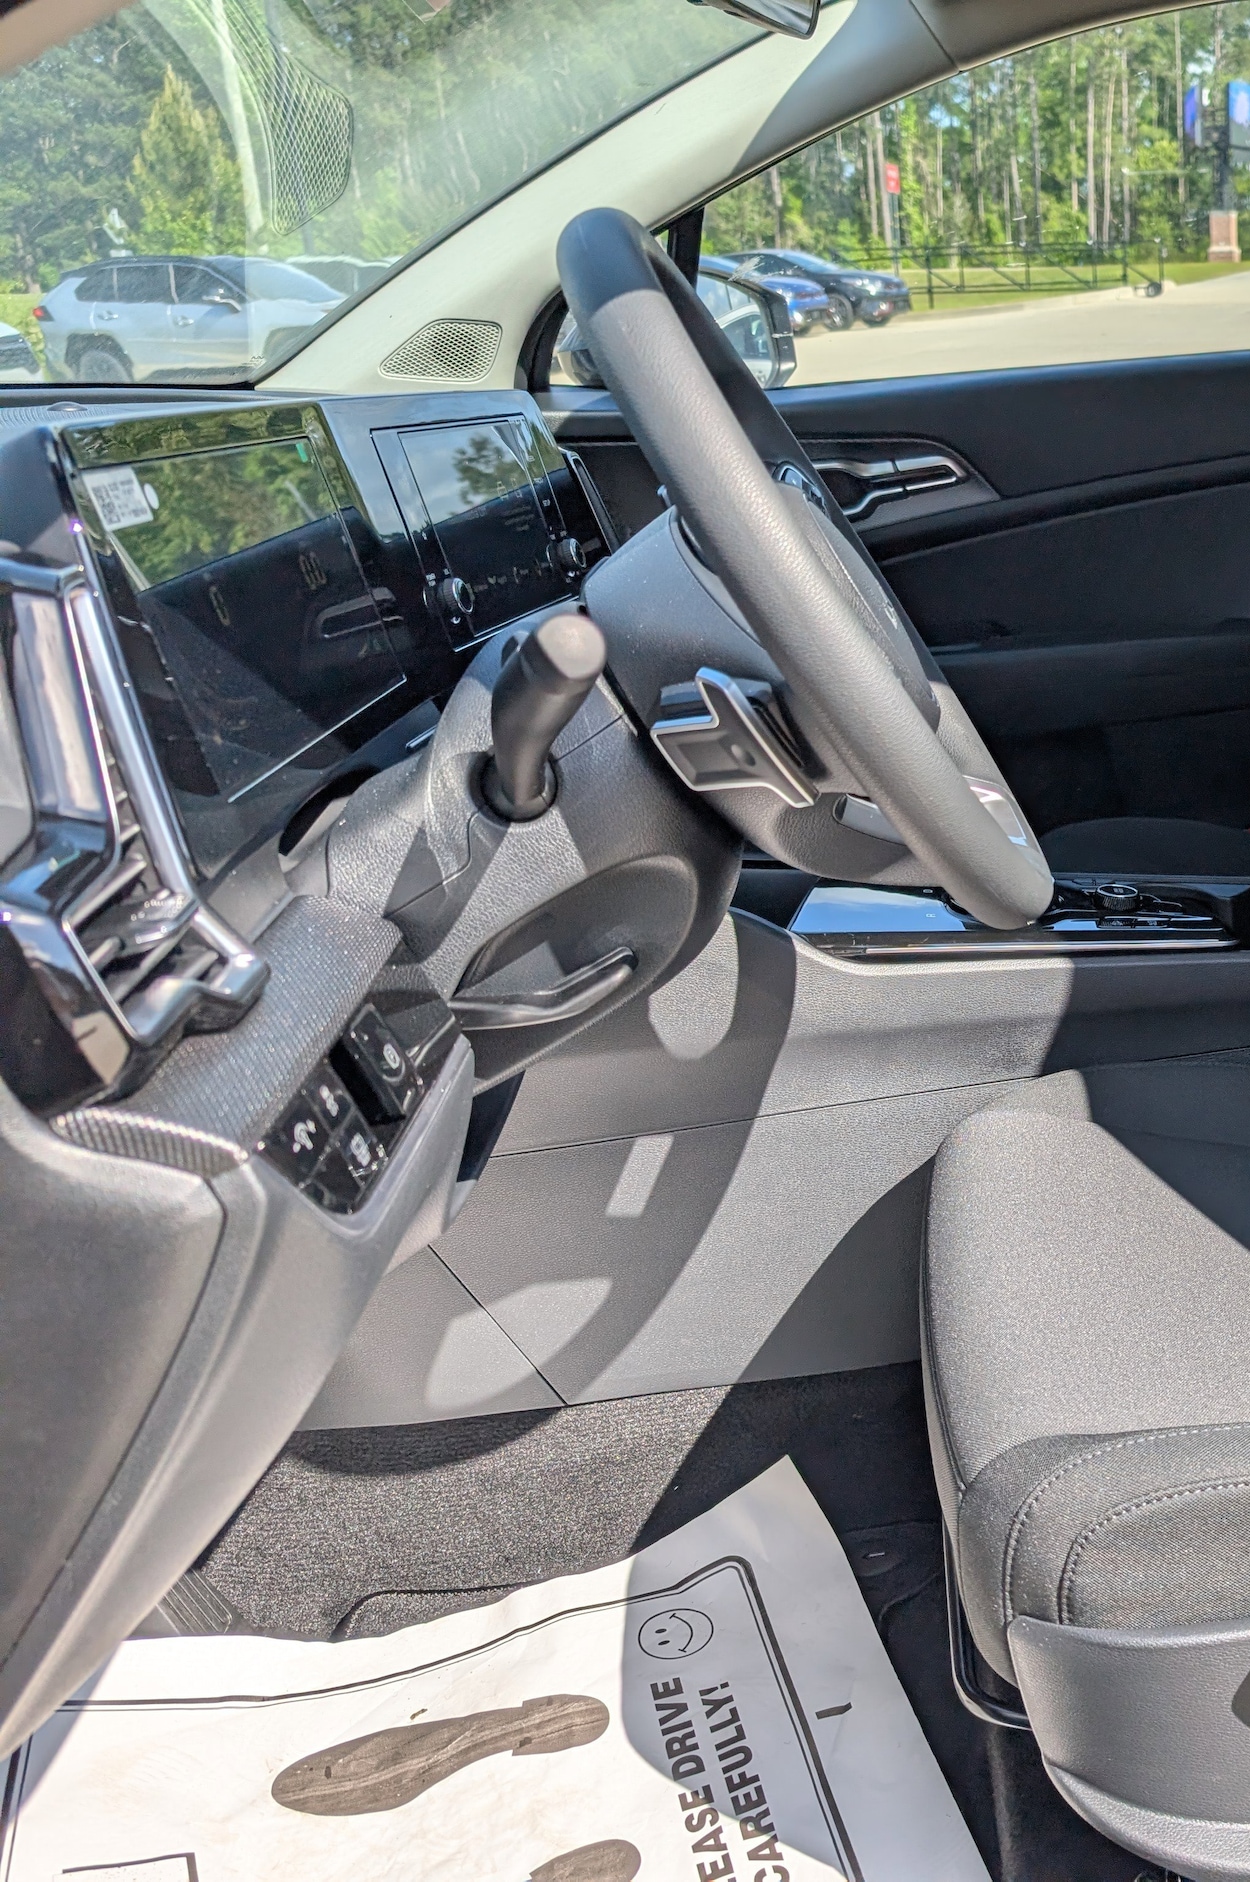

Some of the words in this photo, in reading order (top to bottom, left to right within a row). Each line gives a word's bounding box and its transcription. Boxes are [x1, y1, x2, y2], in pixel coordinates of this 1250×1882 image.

[650, 1677, 706, 1781] DRIVE
[678, 1784, 737, 1882] EASE
[699, 1681, 790, 1882] CAREFULLY!
